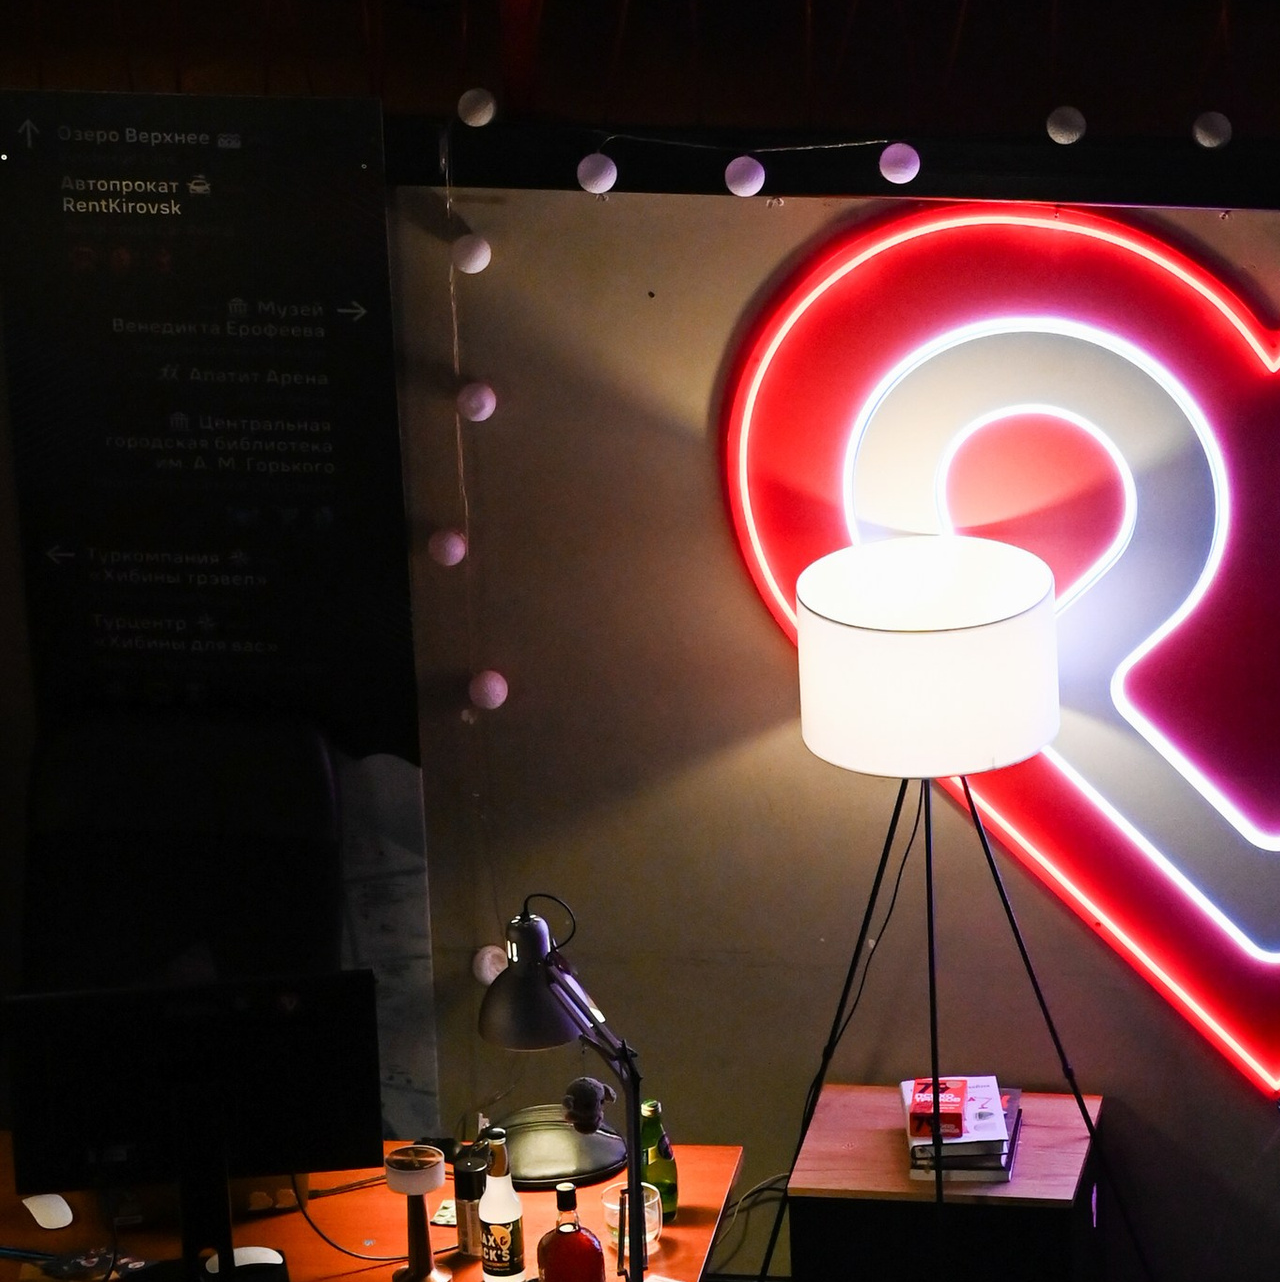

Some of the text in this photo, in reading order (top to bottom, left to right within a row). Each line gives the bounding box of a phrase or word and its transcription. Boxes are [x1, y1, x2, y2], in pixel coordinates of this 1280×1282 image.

[57, 124, 210, 147] Озеро Верхнее
[60, 174, 179, 195] Автопрокат
[62, 197, 182, 216] RentKirovsk
[257, 300, 324, 319] Музей
[112, 317, 326, 339] Венедикта Ерофеева
[189, 366, 329, 387] Апатит Арена
[199, 414, 331, 433] Центральная
[104, 434, 333, 454] городская библиотека
[246, 457, 336, 475] Горького
[87, 546, 220, 565] Туркомпания
[92, 613, 187, 632] Турцентр
[480, 1231, 496, 1248] AX
[483, 1247, 511, 1261] CK'S
